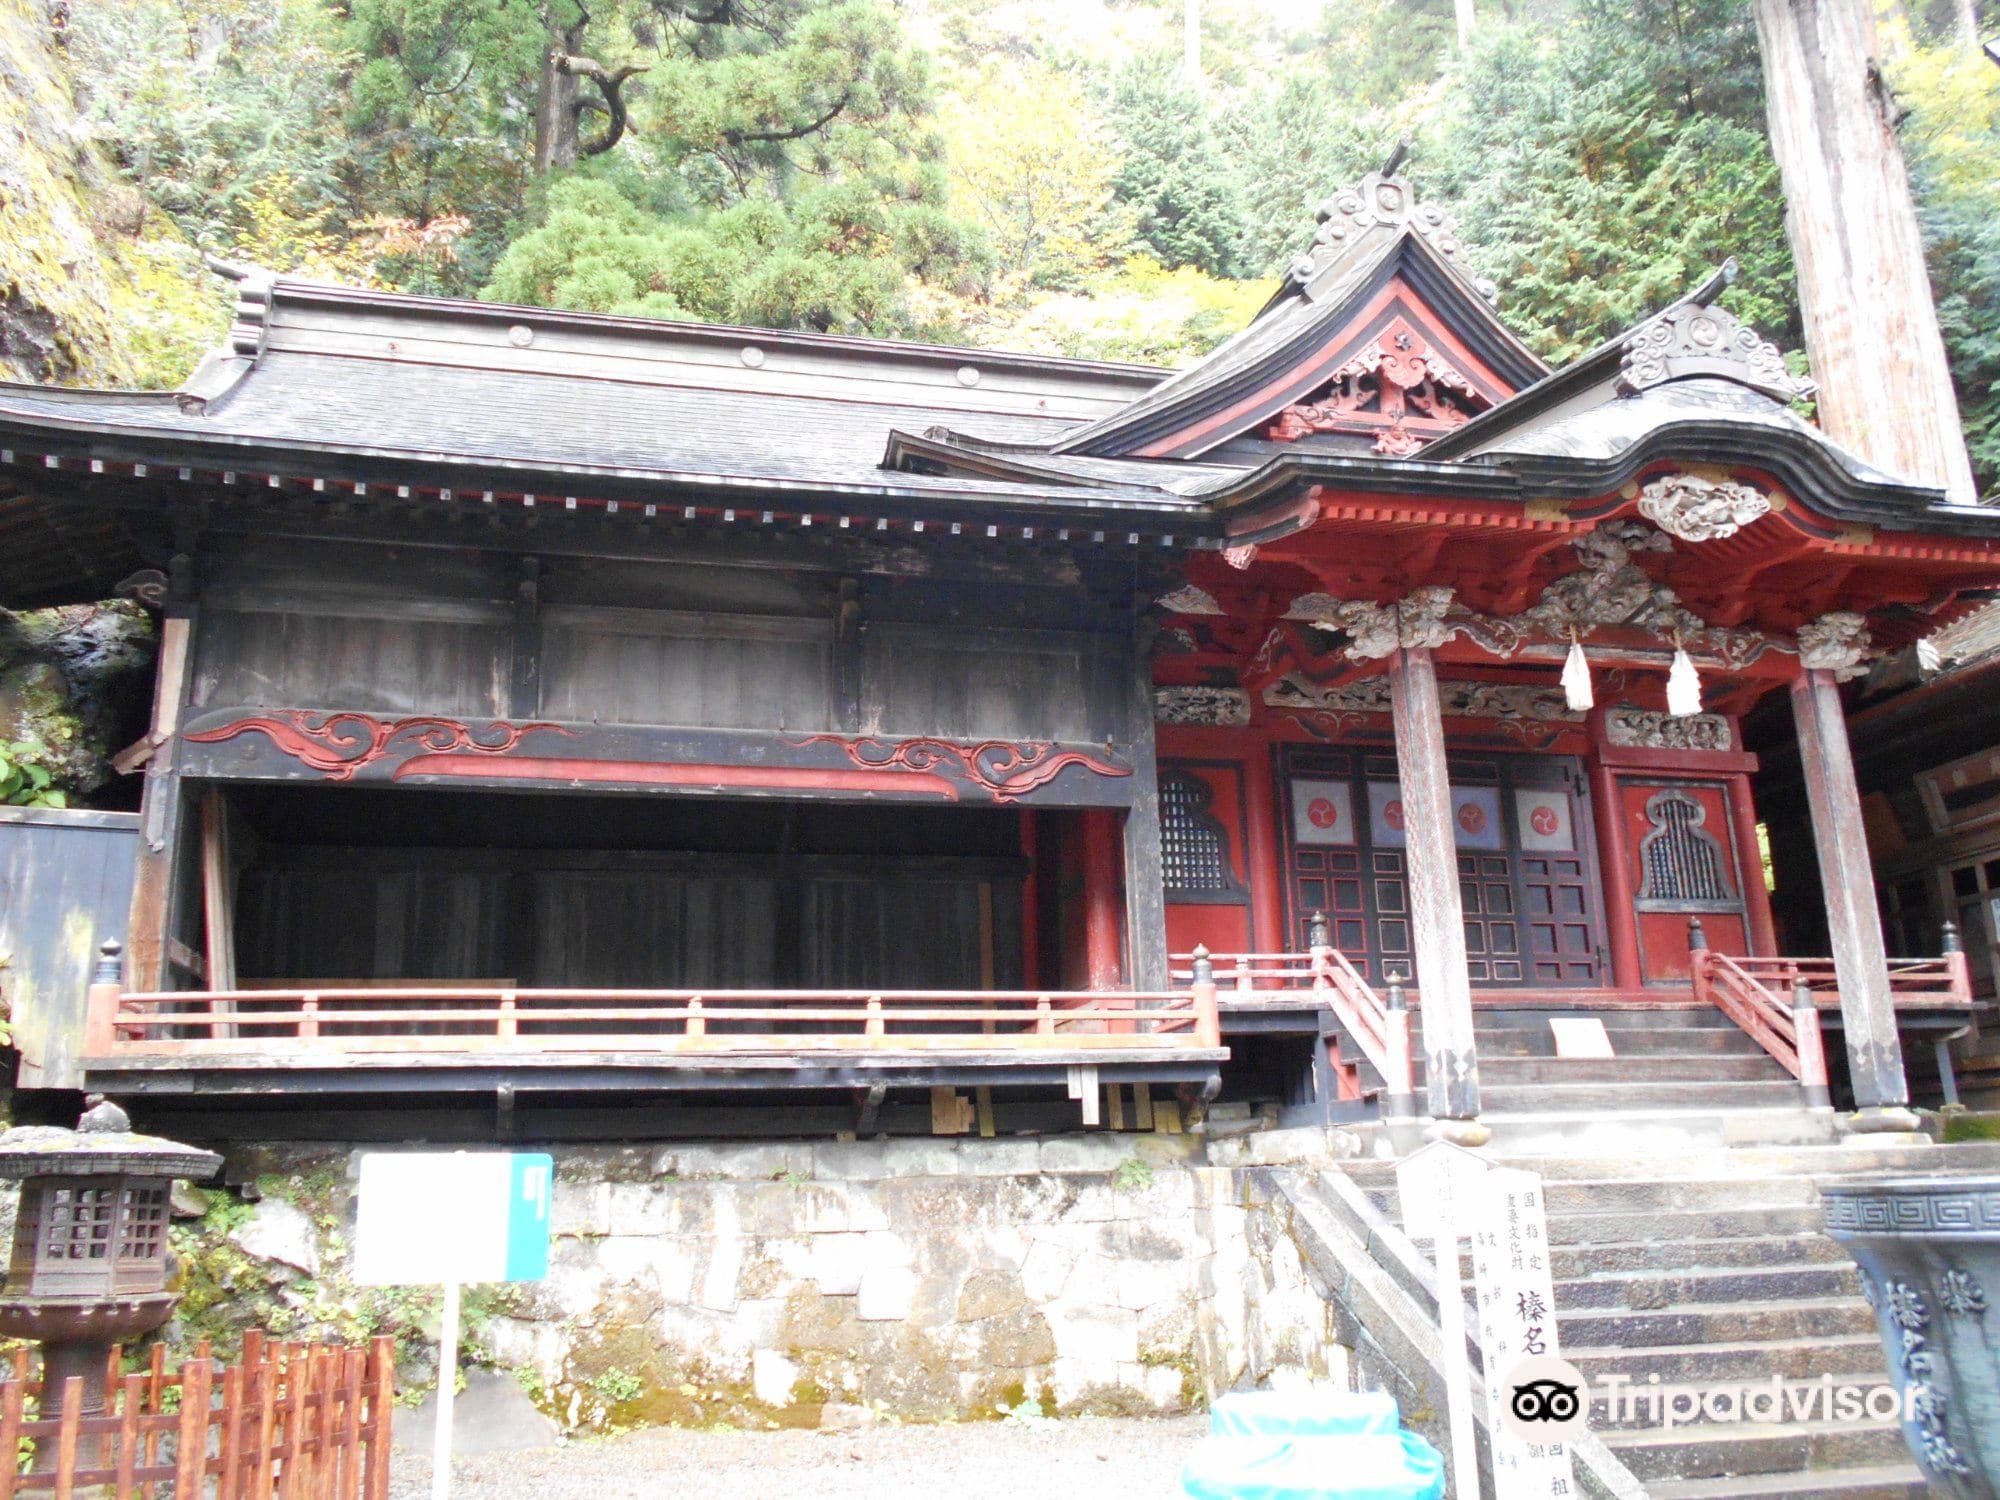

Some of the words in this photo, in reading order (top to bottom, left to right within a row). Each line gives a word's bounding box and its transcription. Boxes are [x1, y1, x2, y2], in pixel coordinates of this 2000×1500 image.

[1507, 1194, 1523, 1270] 重要文化財
[1524, 1192, 1542, 1271] 国指定
